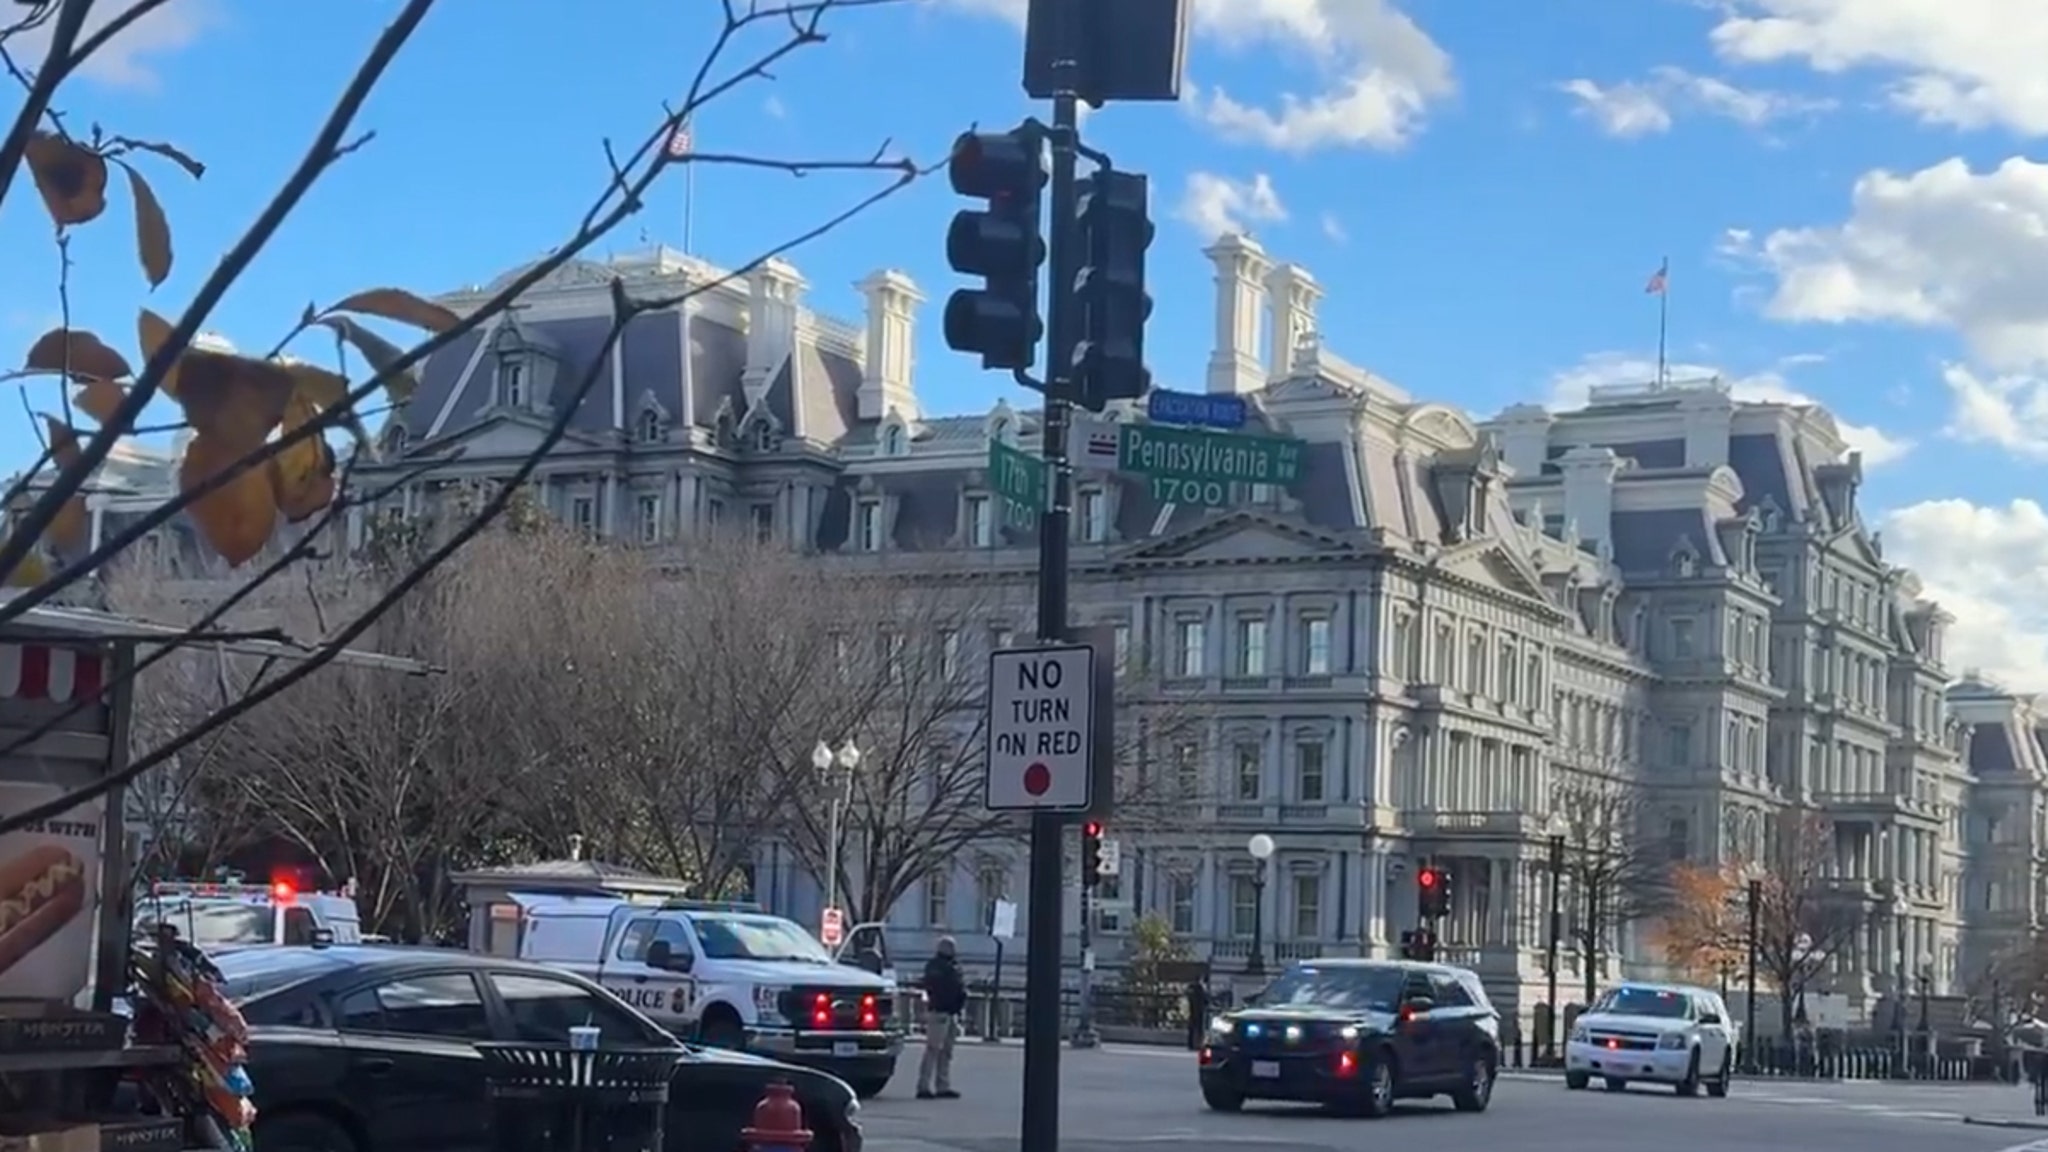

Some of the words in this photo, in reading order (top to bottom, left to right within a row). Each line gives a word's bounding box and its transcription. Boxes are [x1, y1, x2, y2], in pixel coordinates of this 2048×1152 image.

[1127, 430, 1268, 477] Pennsylvania
[1001, 452, 1029, 496] 17th
[1153, 477, 1222, 505] 1700
[1019, 660, 1062, 690] NO
[1012, 698, 1069, 723] TURN
[997, 733, 1026, 756] ON
[1037, 731, 1081, 755] RED
